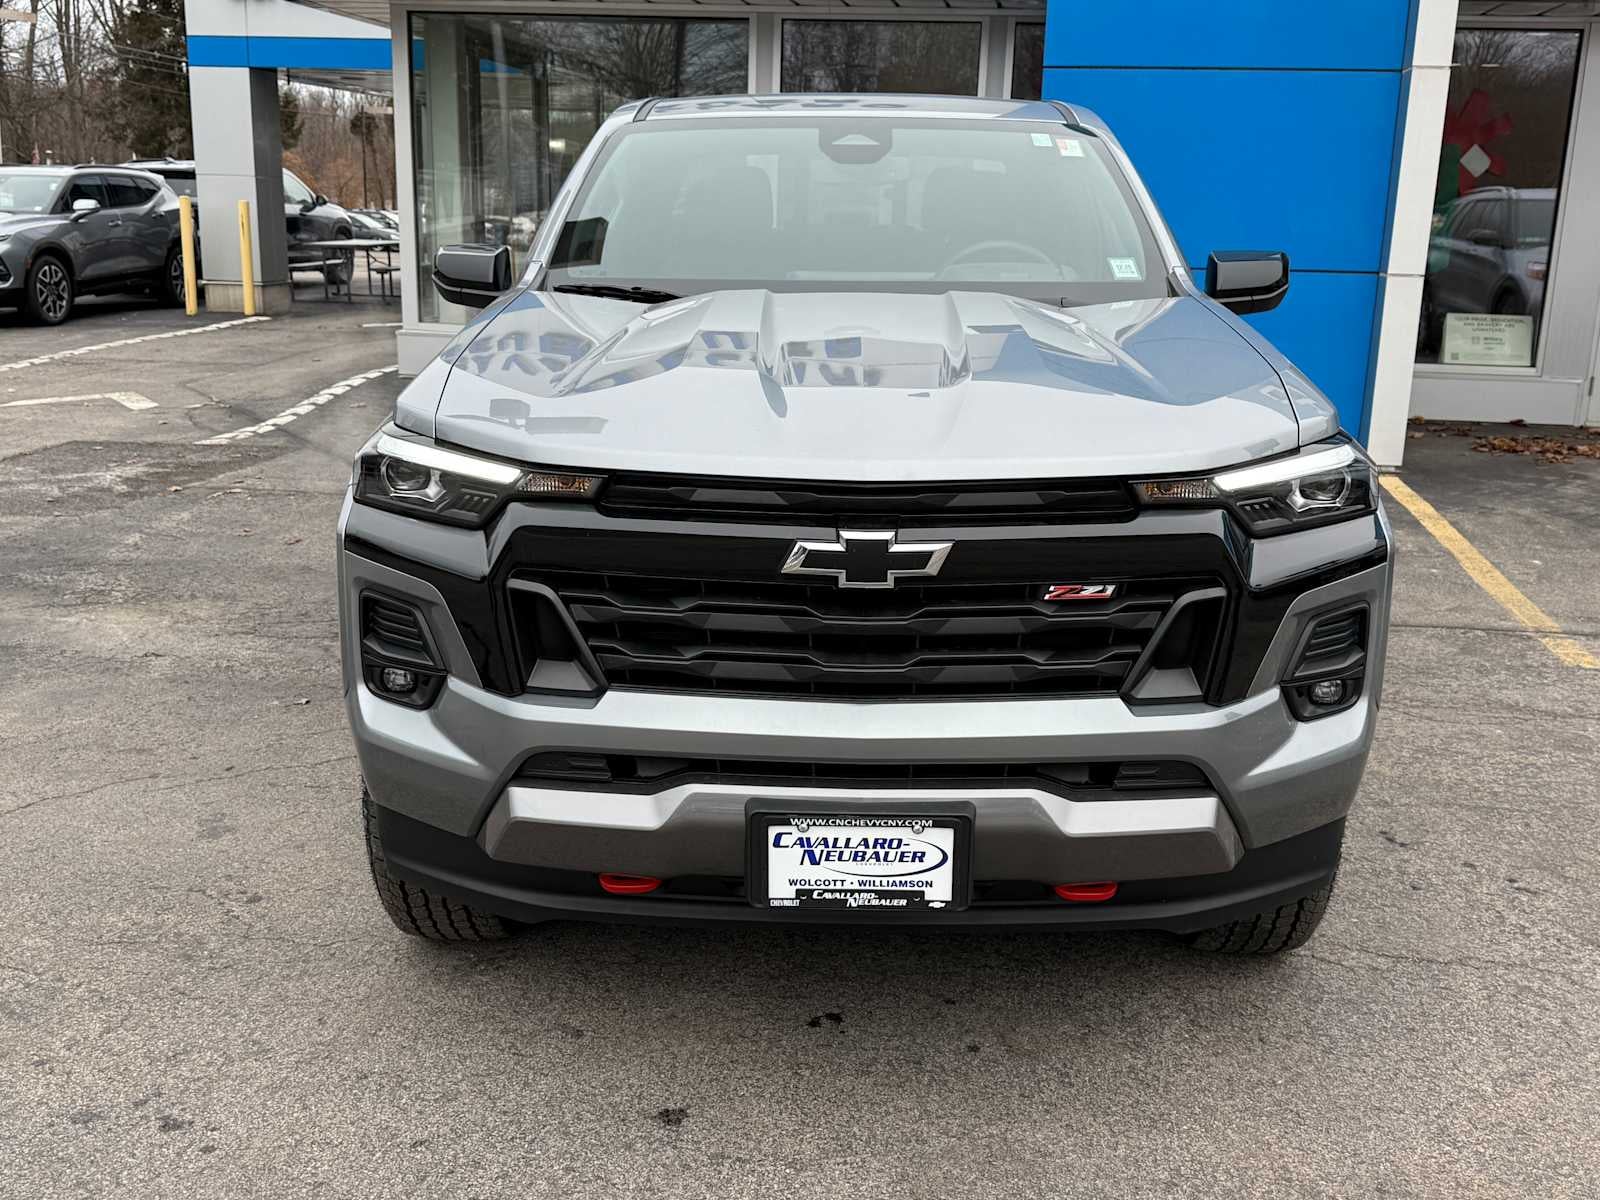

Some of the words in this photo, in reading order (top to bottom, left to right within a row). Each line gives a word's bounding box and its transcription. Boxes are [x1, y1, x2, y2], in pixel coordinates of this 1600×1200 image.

[1044, 584, 1116, 600] Z71
[790, 818, 933, 828] WWW.CNCHEVYCNY.COM
[773, 832, 910, 850] CAVALLARO-
[800, 849, 926, 866] NEUBAUER
[788, 878, 846, 887] WOLCOTT
[857, 879, 933, 888] WILLIAMSON
[846, 898, 908, 907] NEUBAUER
